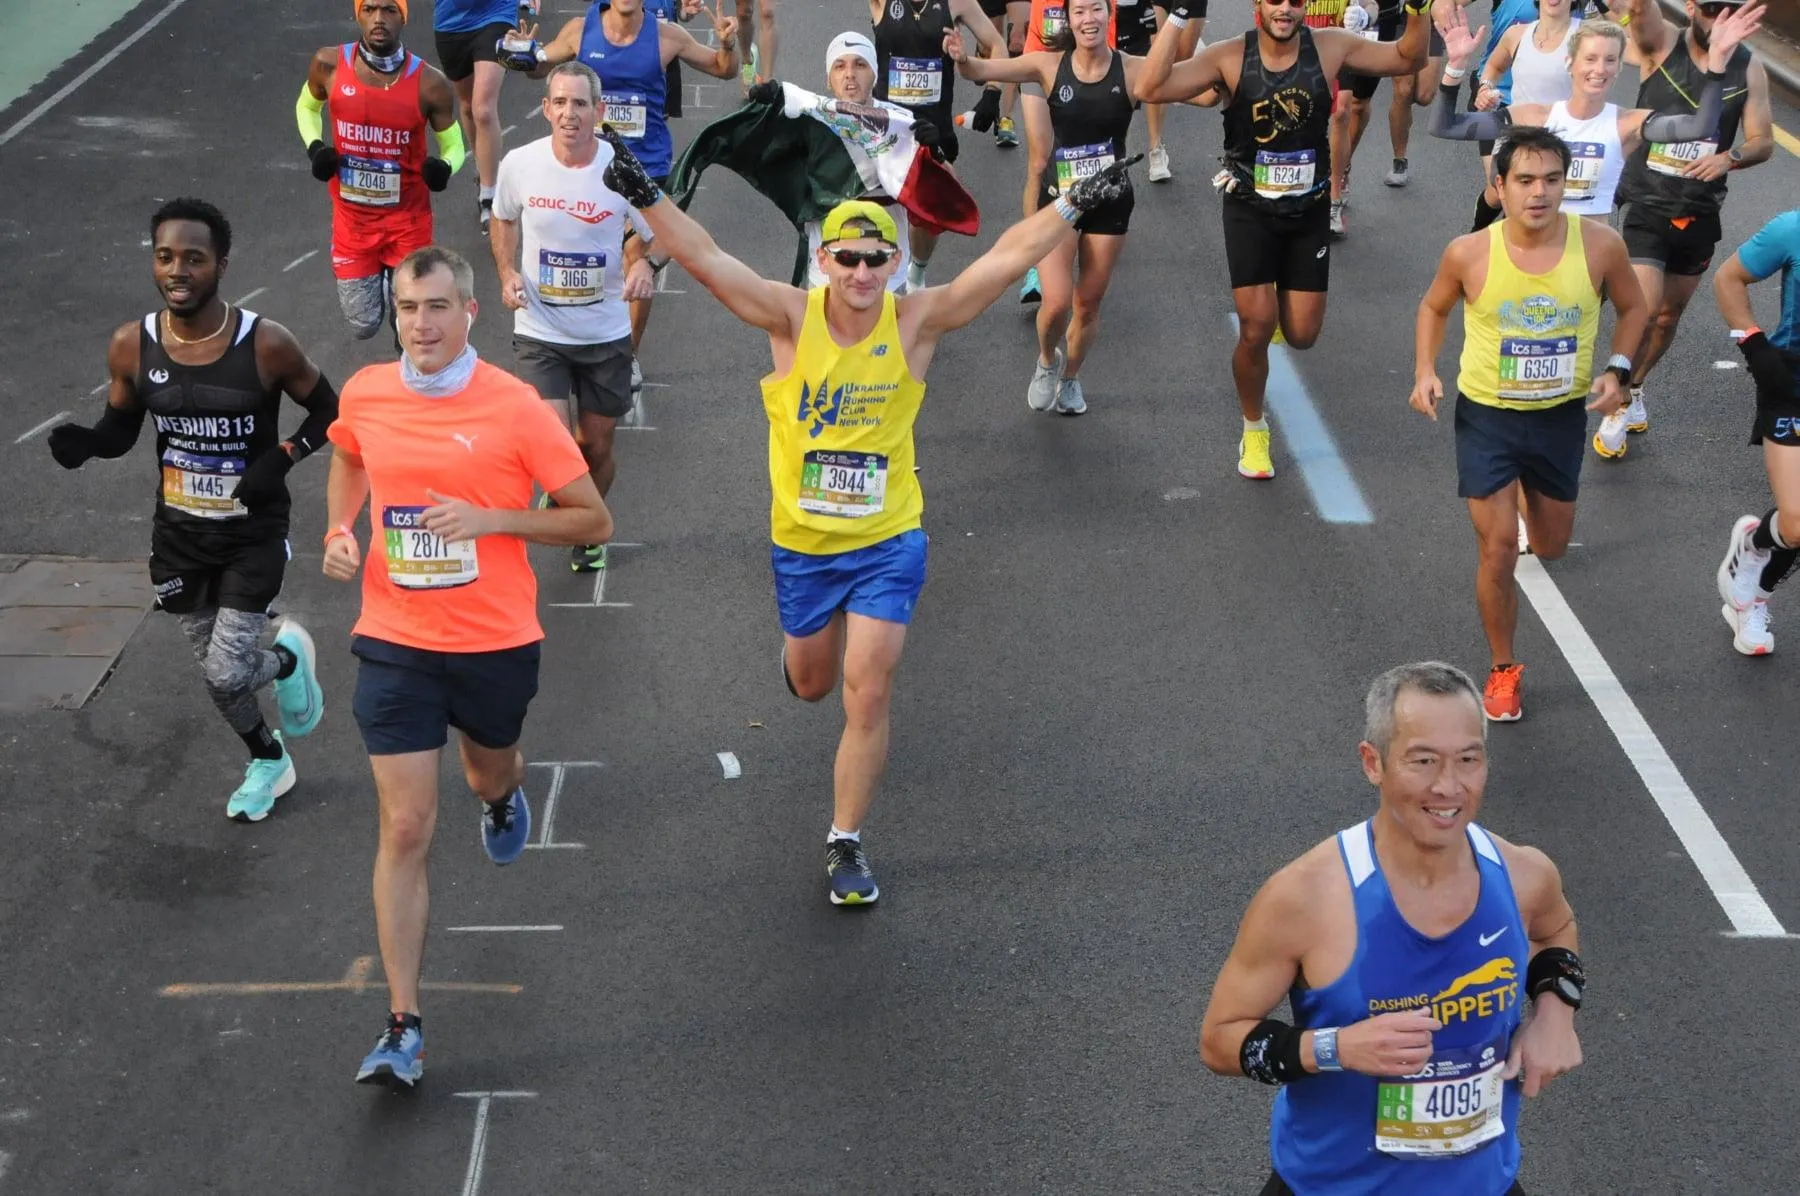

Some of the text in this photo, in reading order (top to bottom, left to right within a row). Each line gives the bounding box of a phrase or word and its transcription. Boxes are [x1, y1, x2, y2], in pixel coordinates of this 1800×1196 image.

[905, 73, 929, 88] 3229
[608, 106, 632, 121] 3035
[337, 119, 409, 144] WERUN313
[359, 172, 386, 190] 2048
[1274, 166, 1301, 184] 6234
[528, 195, 597, 215] saucny
[561, 270, 588, 287] 3166
[1524, 358, 1558, 379] 6350
[153, 414, 255, 438] WERUN313
[839, 416, 881, 427] New York
[192, 474, 223, 498] 1445
[828, 467, 866, 493] 3944
[1369, 994, 1429, 1010] DASHING
[1432, 982, 1517, 1025] IPPETS
[1425, 1077, 1483, 1119] 4095
